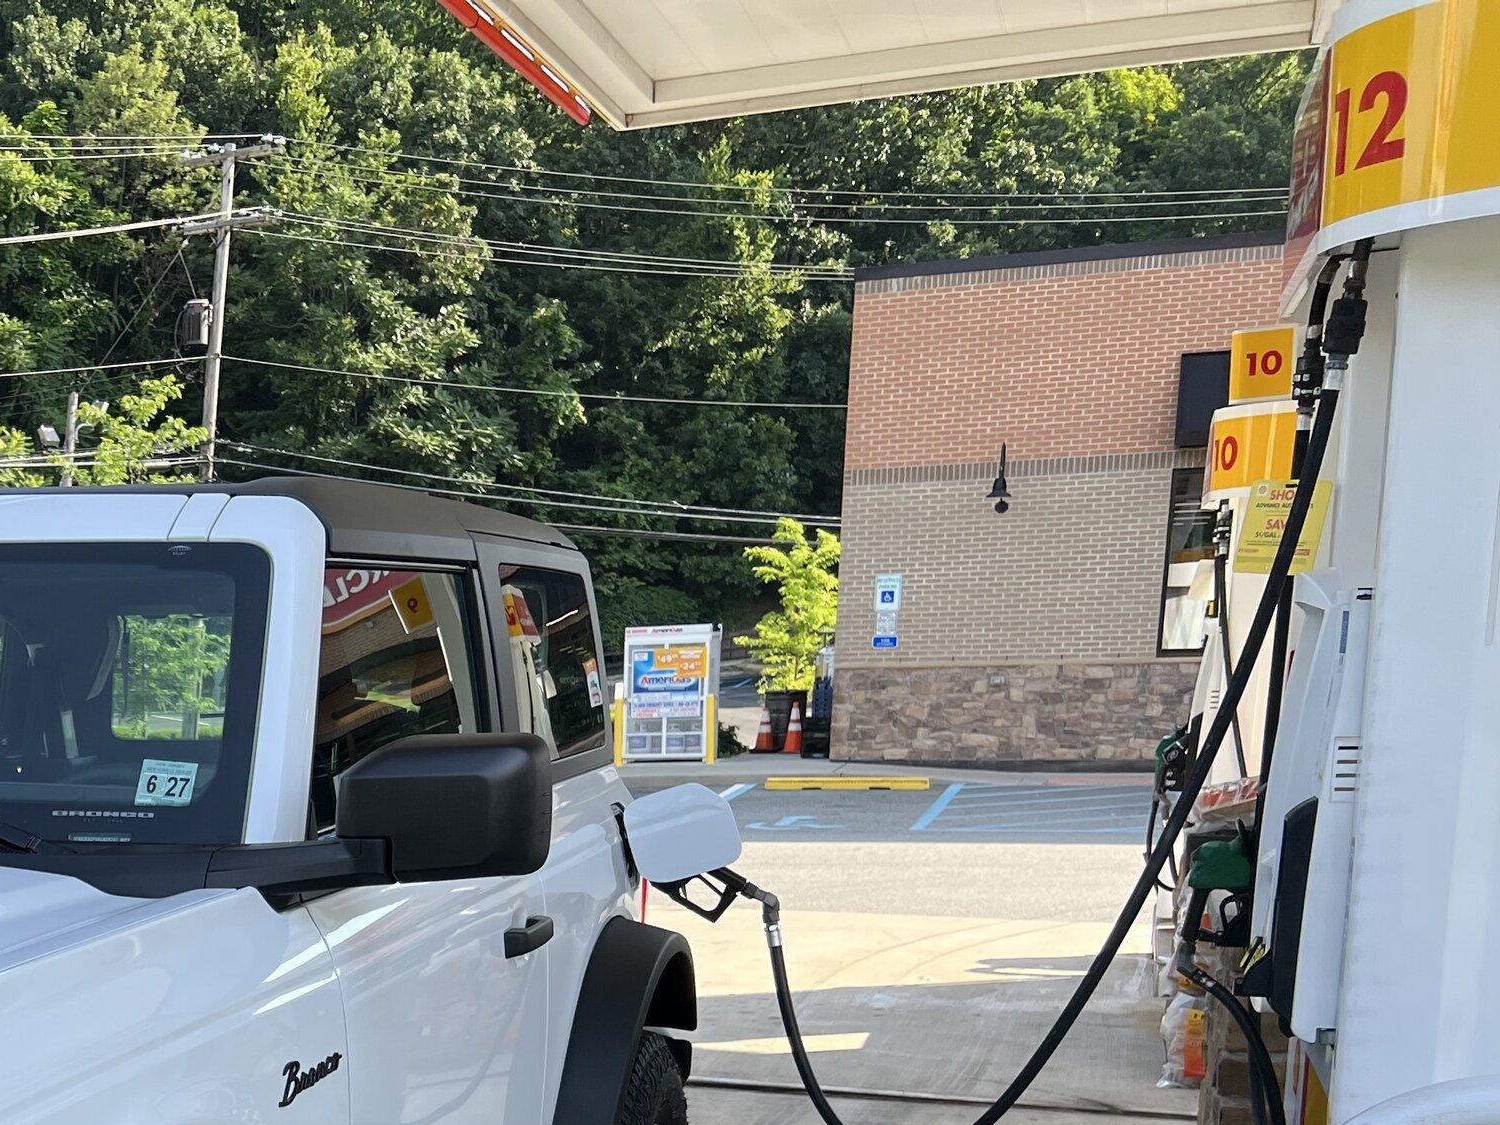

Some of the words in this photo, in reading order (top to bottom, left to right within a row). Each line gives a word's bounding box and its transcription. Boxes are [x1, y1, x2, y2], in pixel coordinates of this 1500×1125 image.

[1334, 70, 1409, 177] 12
[1245, 350, 1282, 376] 10
[1213, 435, 1238, 471] 10
[1269, 489, 1295, 500] SHO
[1266, 519, 1286, 530] SAV
[641, 675, 692, 686] AmeriGas
[146, 775, 158, 794] 6
[165, 776, 191, 797] 27
[52, 810, 155, 818] BRONCO
[279, 1052, 342, 1108] Bronco
